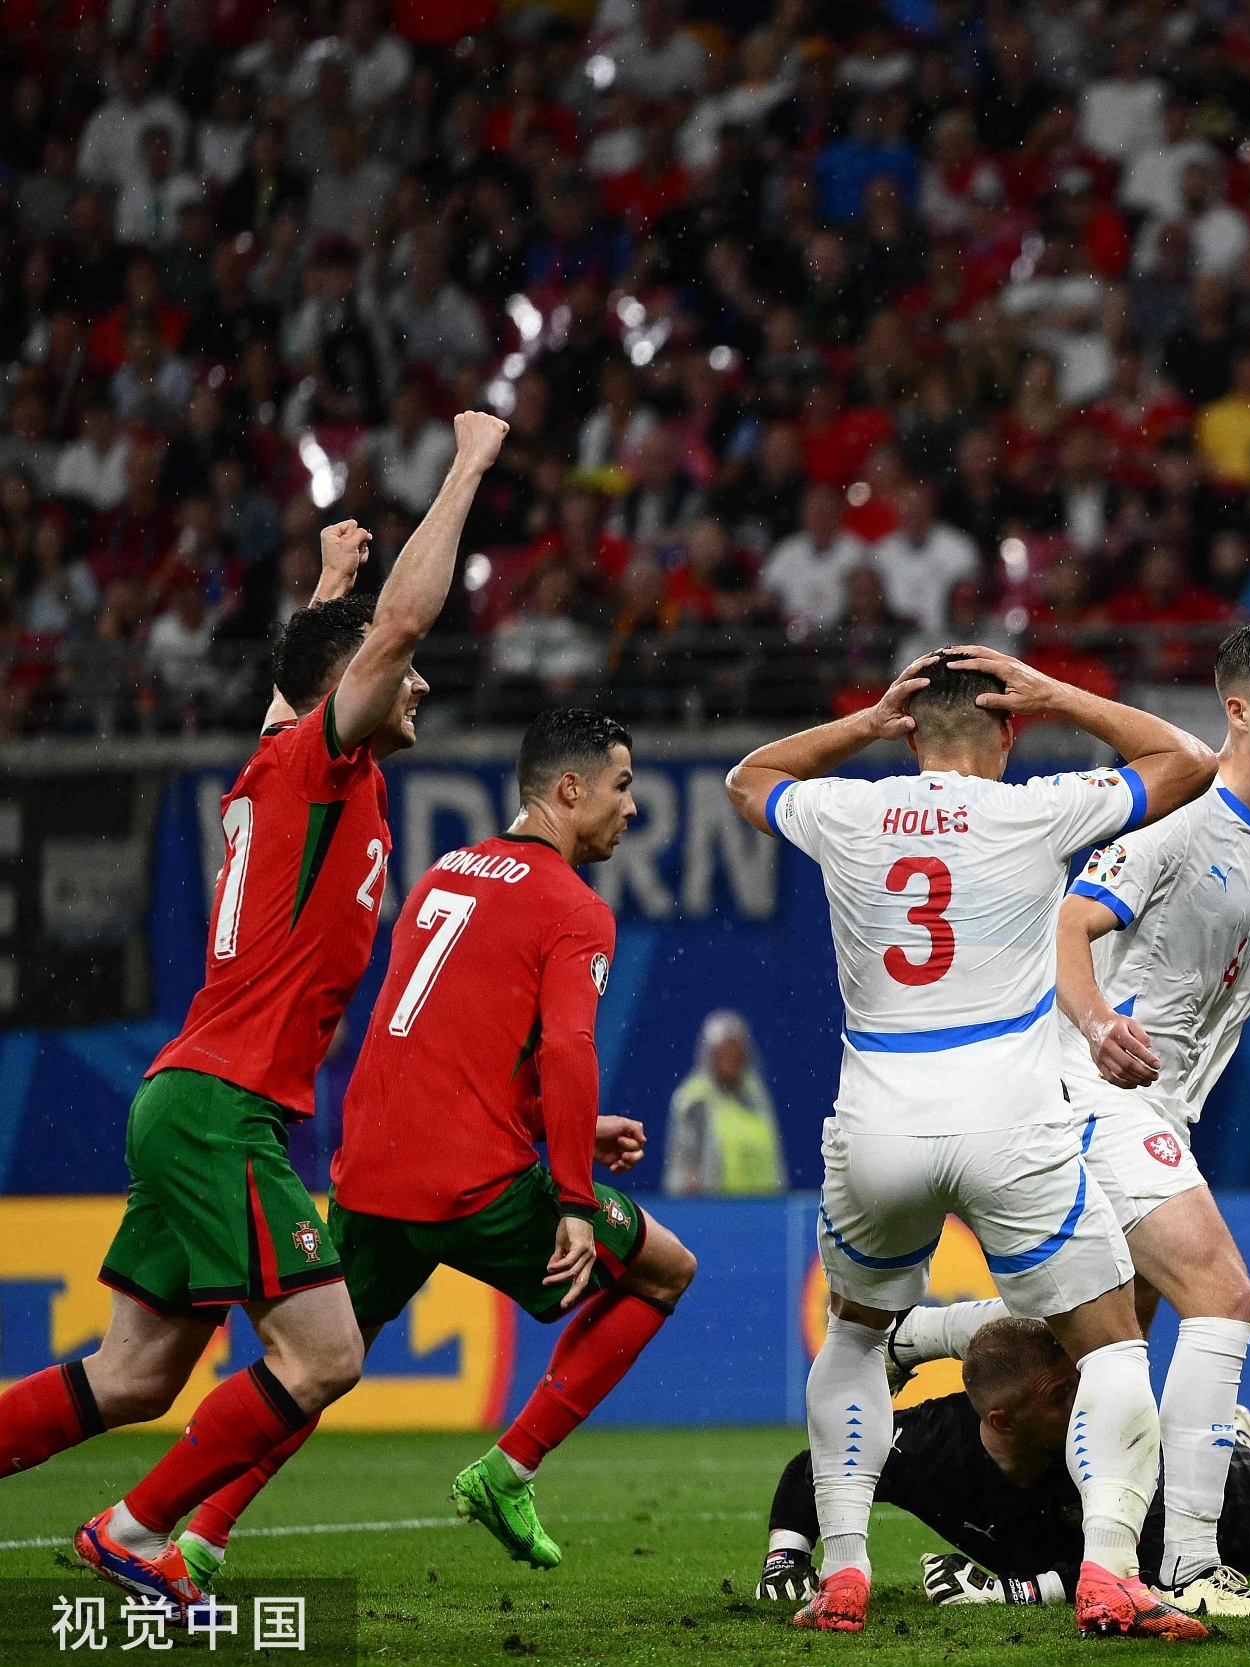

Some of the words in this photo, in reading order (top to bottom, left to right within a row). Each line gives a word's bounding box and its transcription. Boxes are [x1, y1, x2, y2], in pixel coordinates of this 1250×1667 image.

[883, 804, 969, 835] HOLEŠ
[433, 850, 530, 883] RONALDO
[883, 856, 956, 986] 3
[388, 887, 477, 1037] 7
